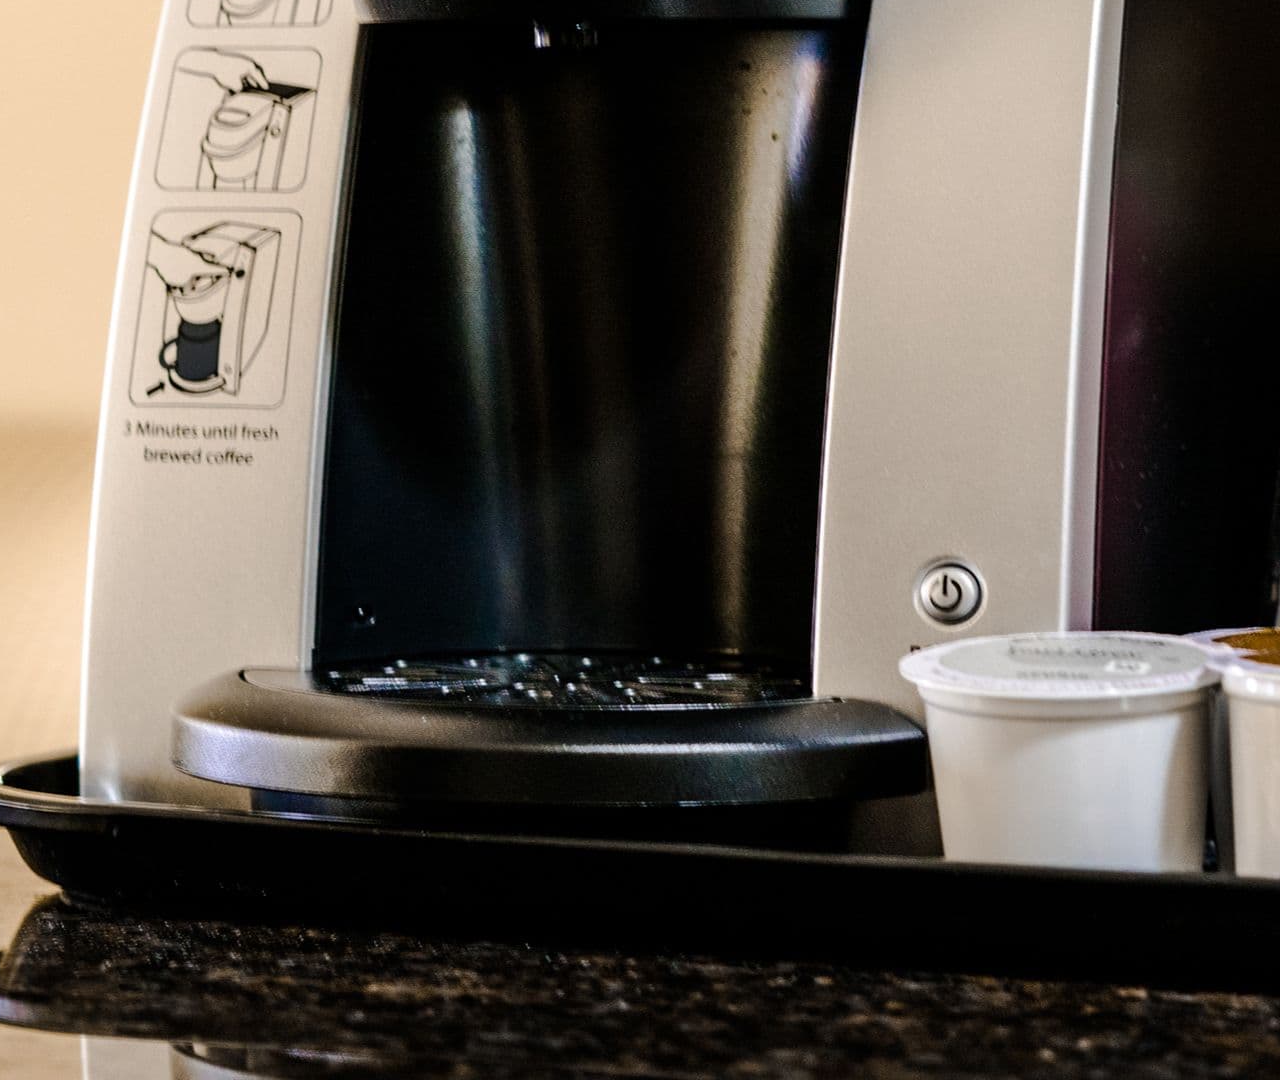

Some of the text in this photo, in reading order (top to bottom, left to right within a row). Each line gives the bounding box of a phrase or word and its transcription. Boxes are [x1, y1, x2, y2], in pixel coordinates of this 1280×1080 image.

[123, 420, 279, 441] 3 Minutes until fresh
[143, 444, 254, 466] brewed coffee
